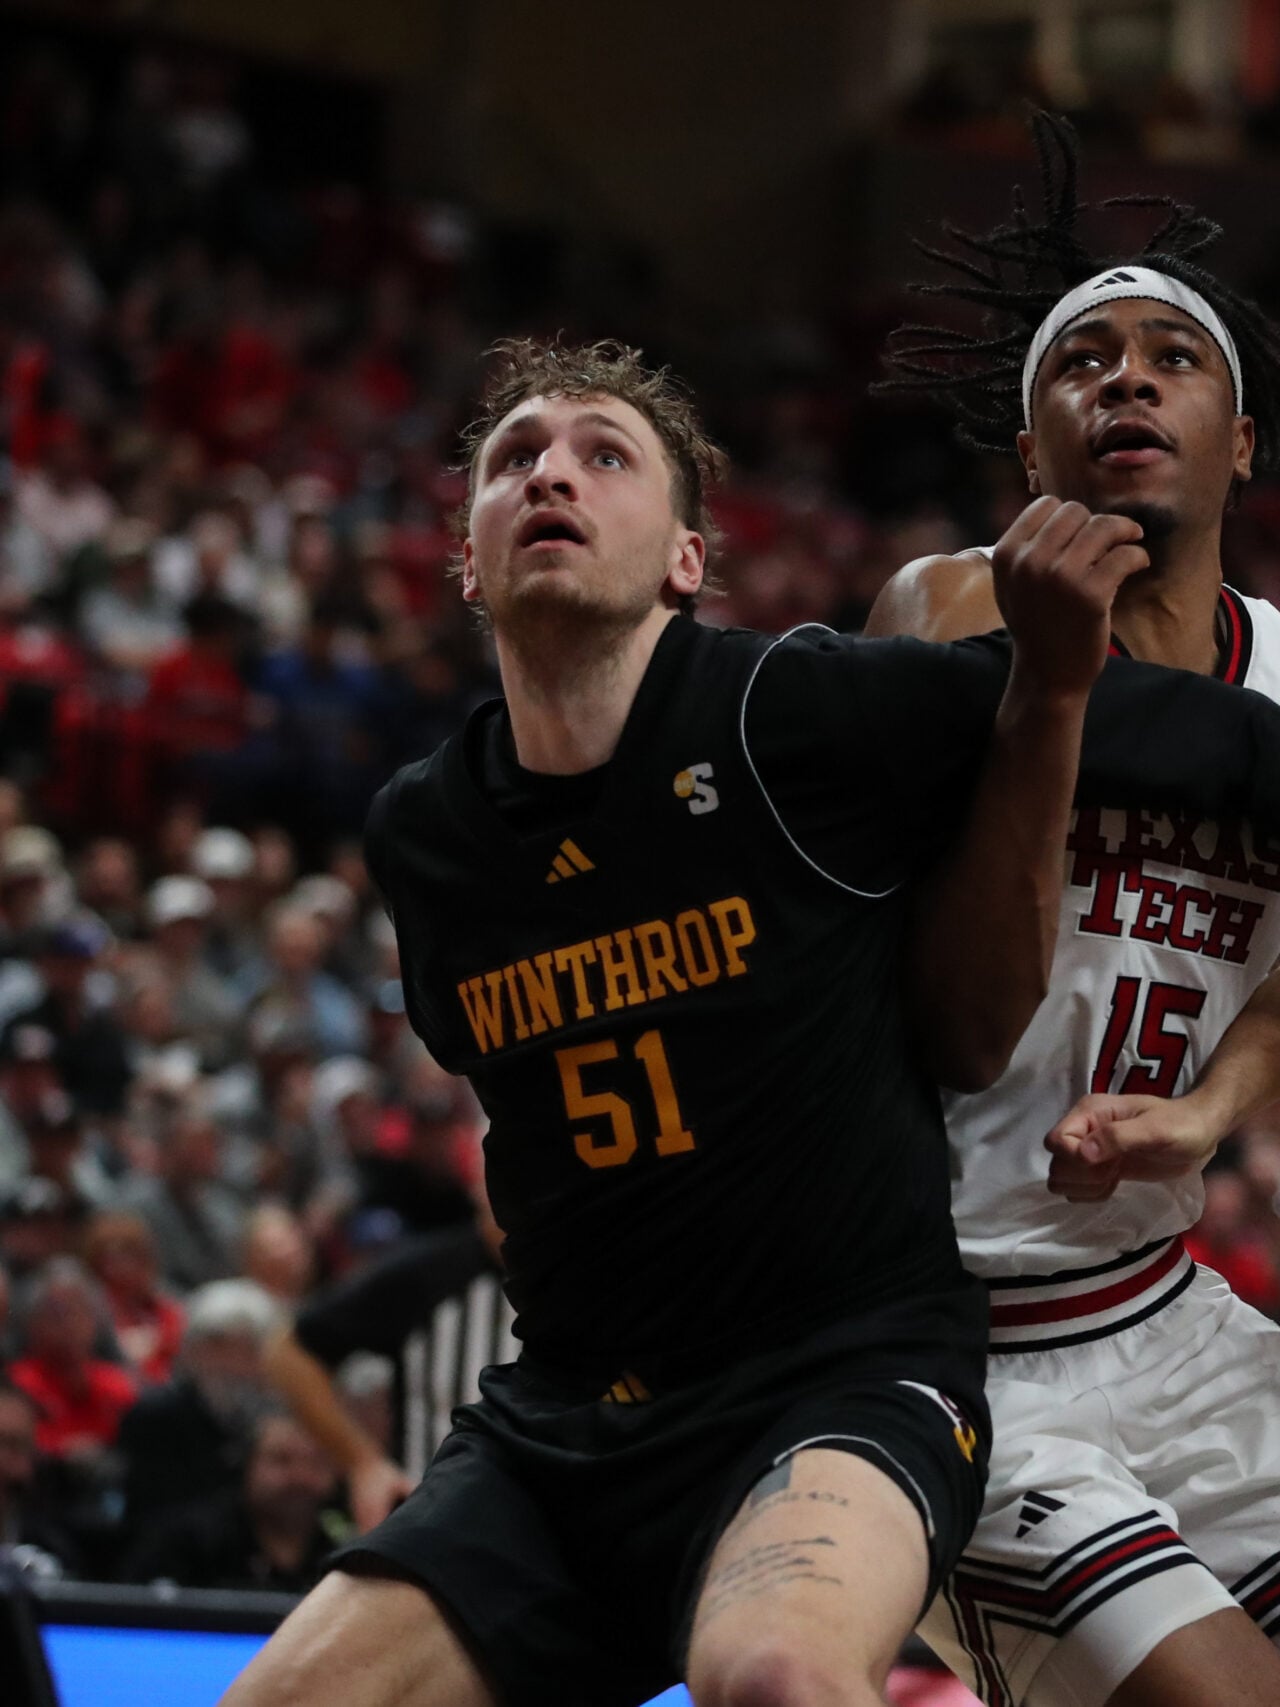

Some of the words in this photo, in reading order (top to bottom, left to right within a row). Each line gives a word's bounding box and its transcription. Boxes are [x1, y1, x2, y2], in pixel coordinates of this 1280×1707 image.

[1070, 854, 1264, 964] TECH
[456, 895, 757, 1055] WINTHROP
[1091, 976, 1207, 1098] 15
[554, 1029, 696, 1169] 51
